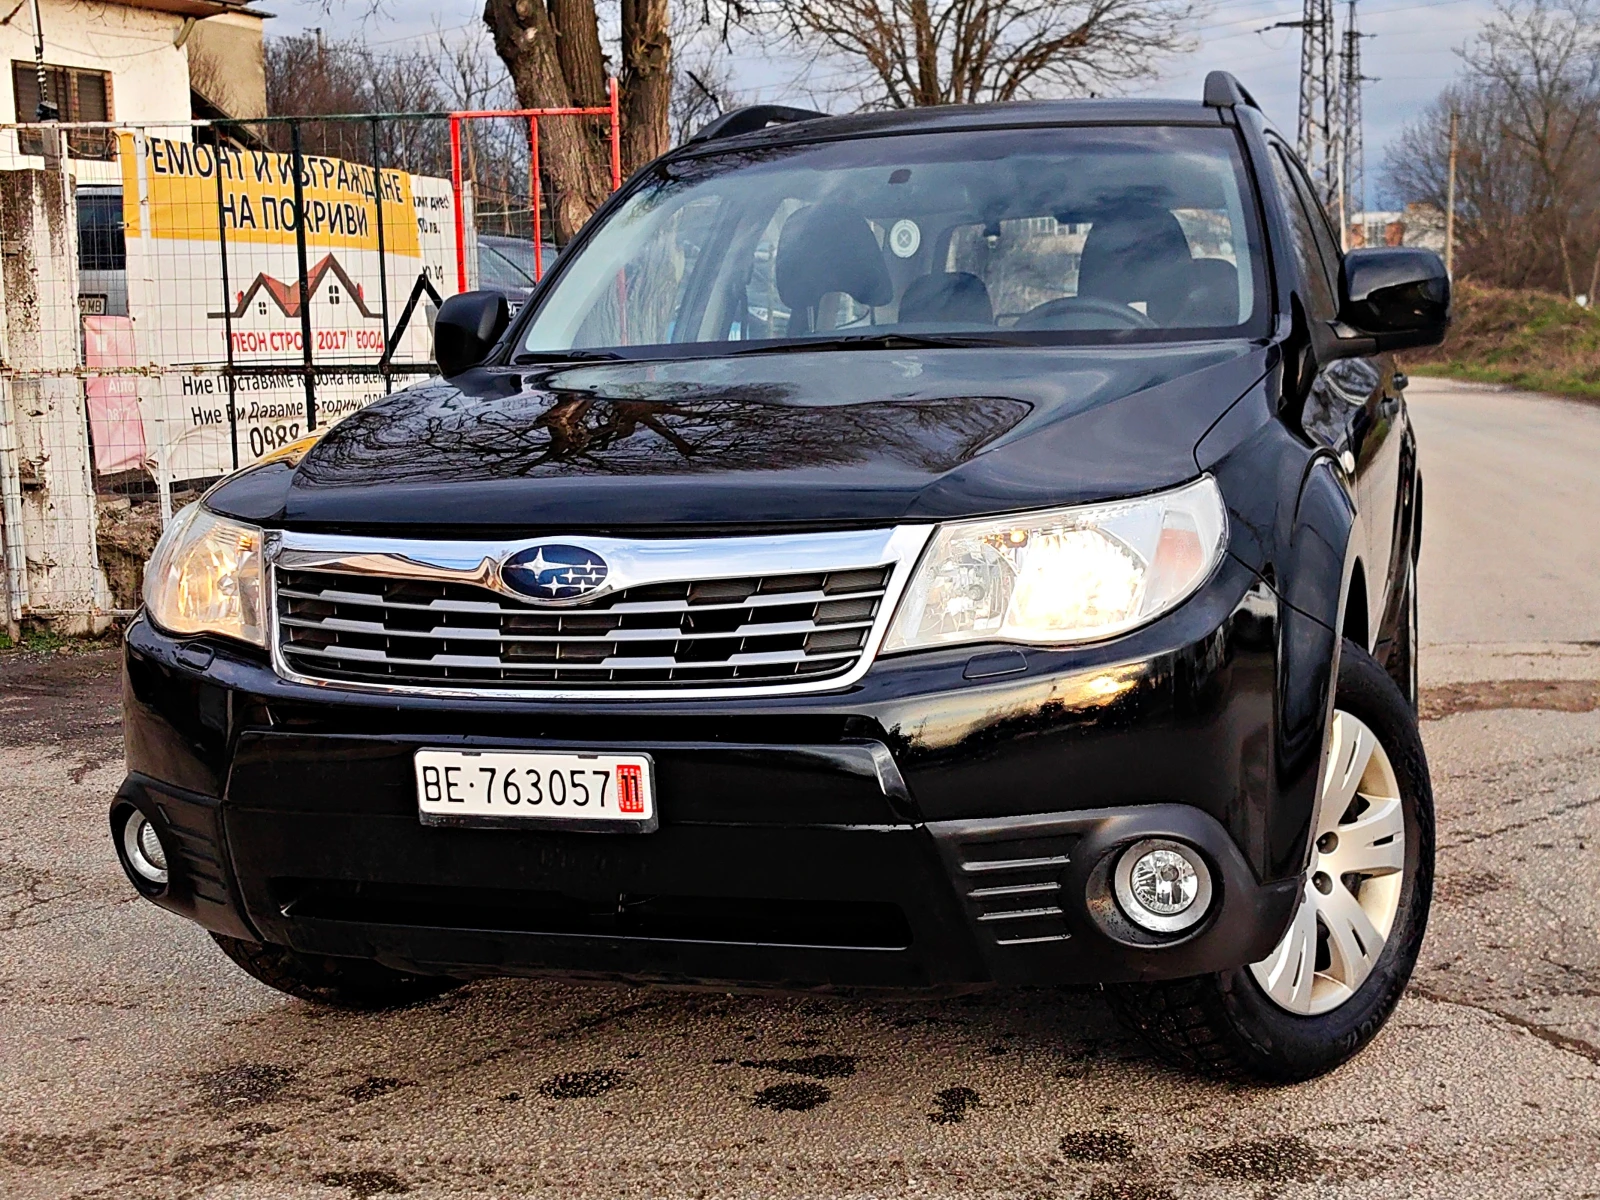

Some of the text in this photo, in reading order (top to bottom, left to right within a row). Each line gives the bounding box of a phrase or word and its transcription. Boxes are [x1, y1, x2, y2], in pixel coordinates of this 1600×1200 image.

[251, 151, 273, 183] И
[222, 194, 369, 237] НА ПОКРИВИ
[270, 330, 313, 352] СТРО
[356, 330, 386, 352] ЕООД
[182, 375, 213, 395] Ние
[191, 406, 222, 425] Ние
[248, 401, 303, 424] Даваме
